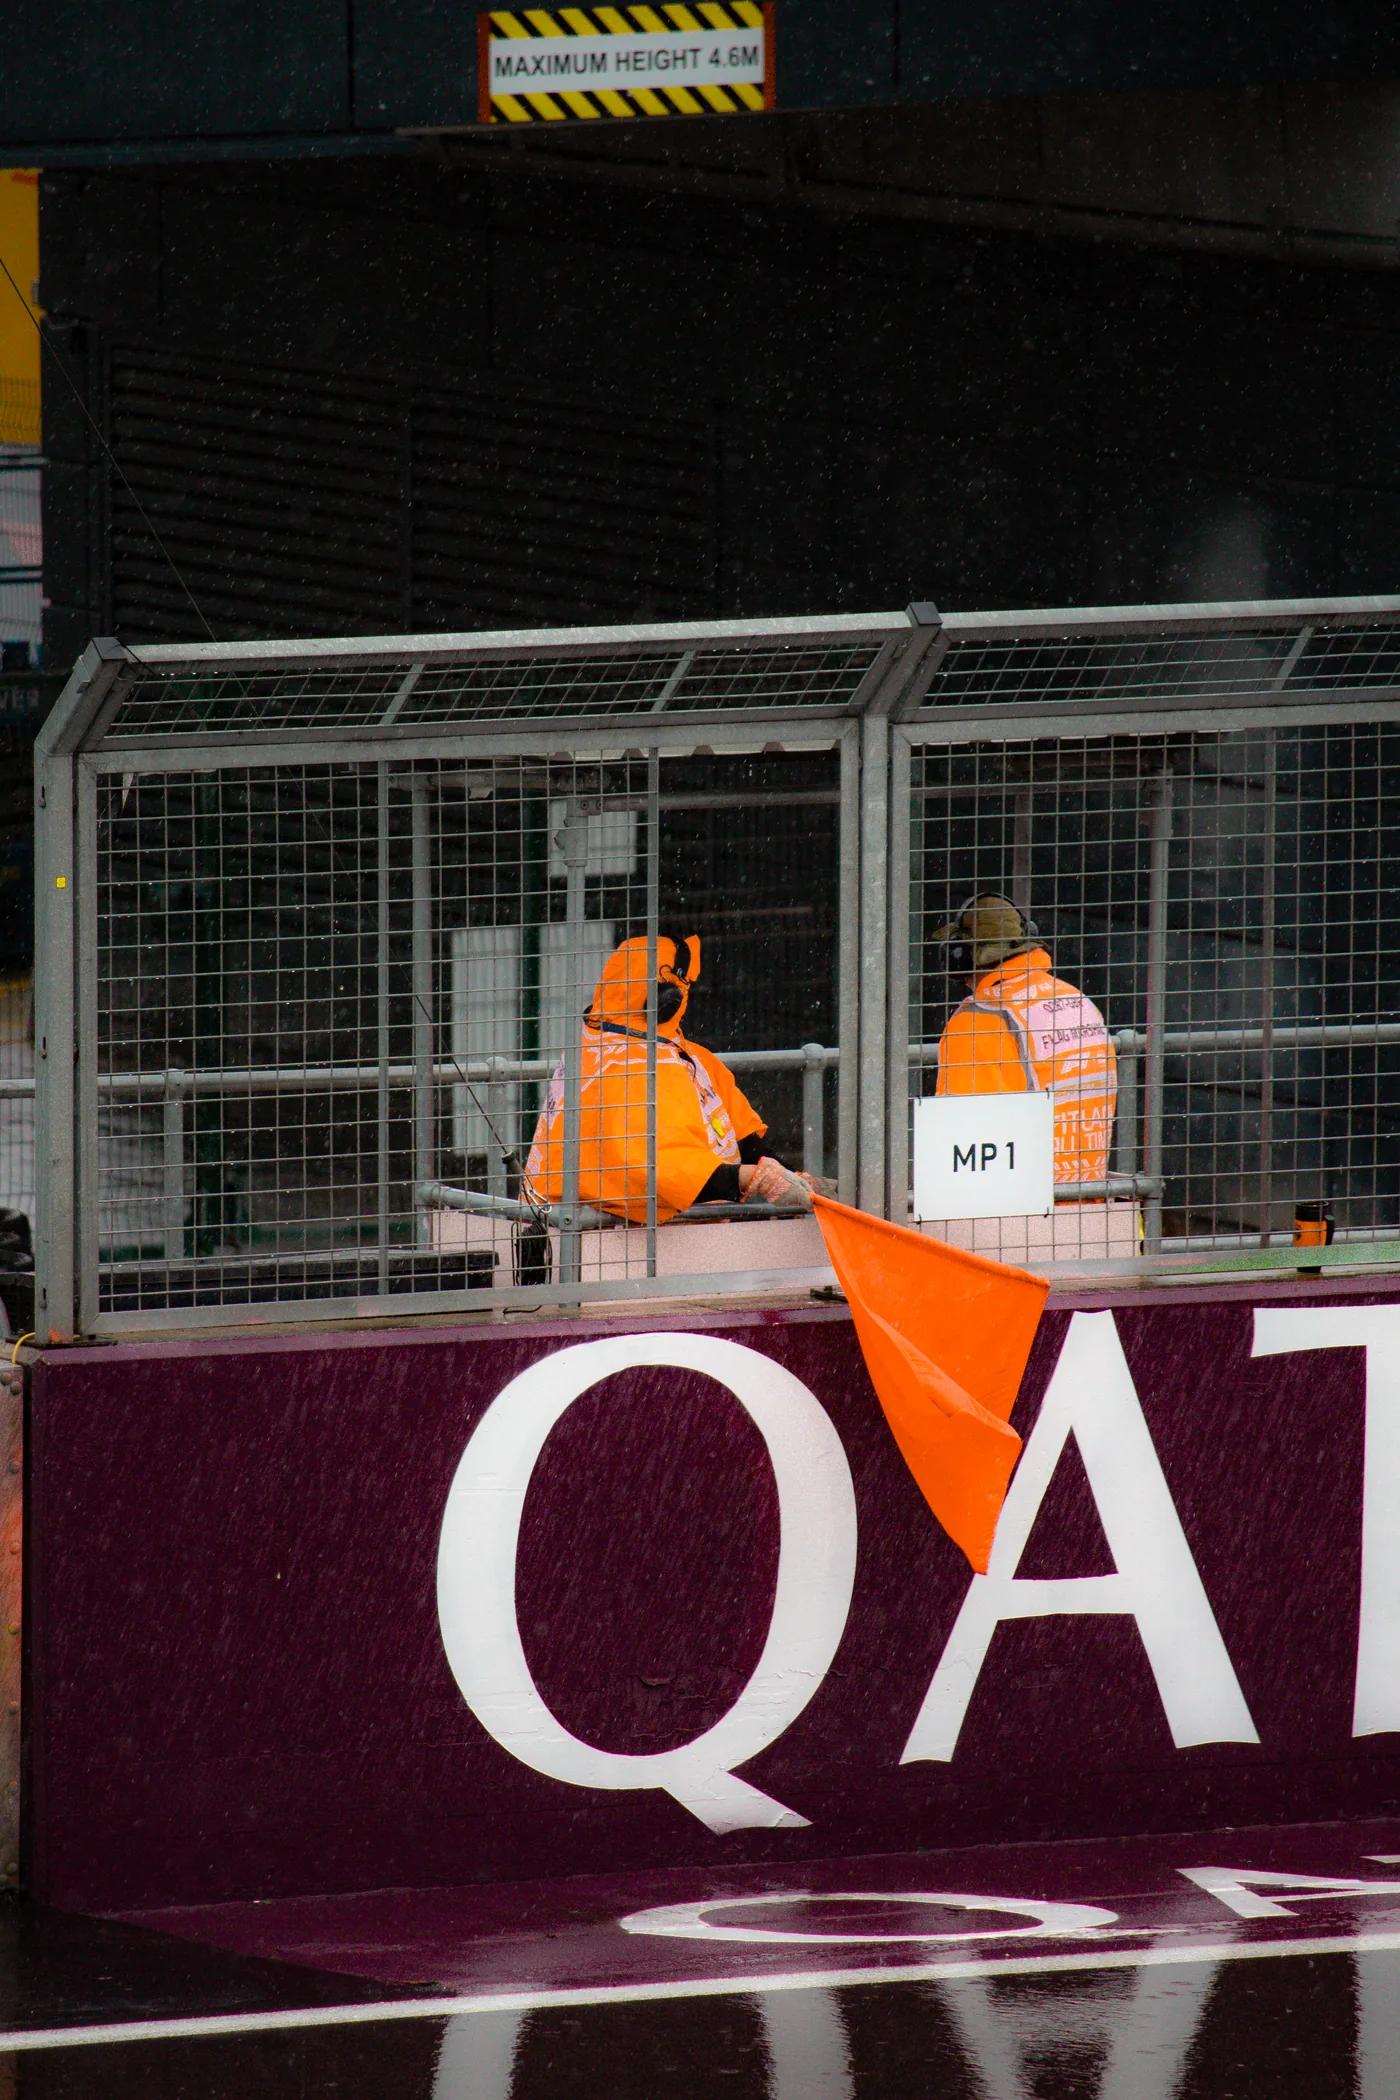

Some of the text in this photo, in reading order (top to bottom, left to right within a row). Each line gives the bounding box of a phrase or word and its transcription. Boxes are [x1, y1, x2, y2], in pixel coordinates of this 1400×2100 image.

[495, 45, 759, 78] MAXIMUM HEIGHT 4.6M
[953, 1141, 1014, 1173] MP1
